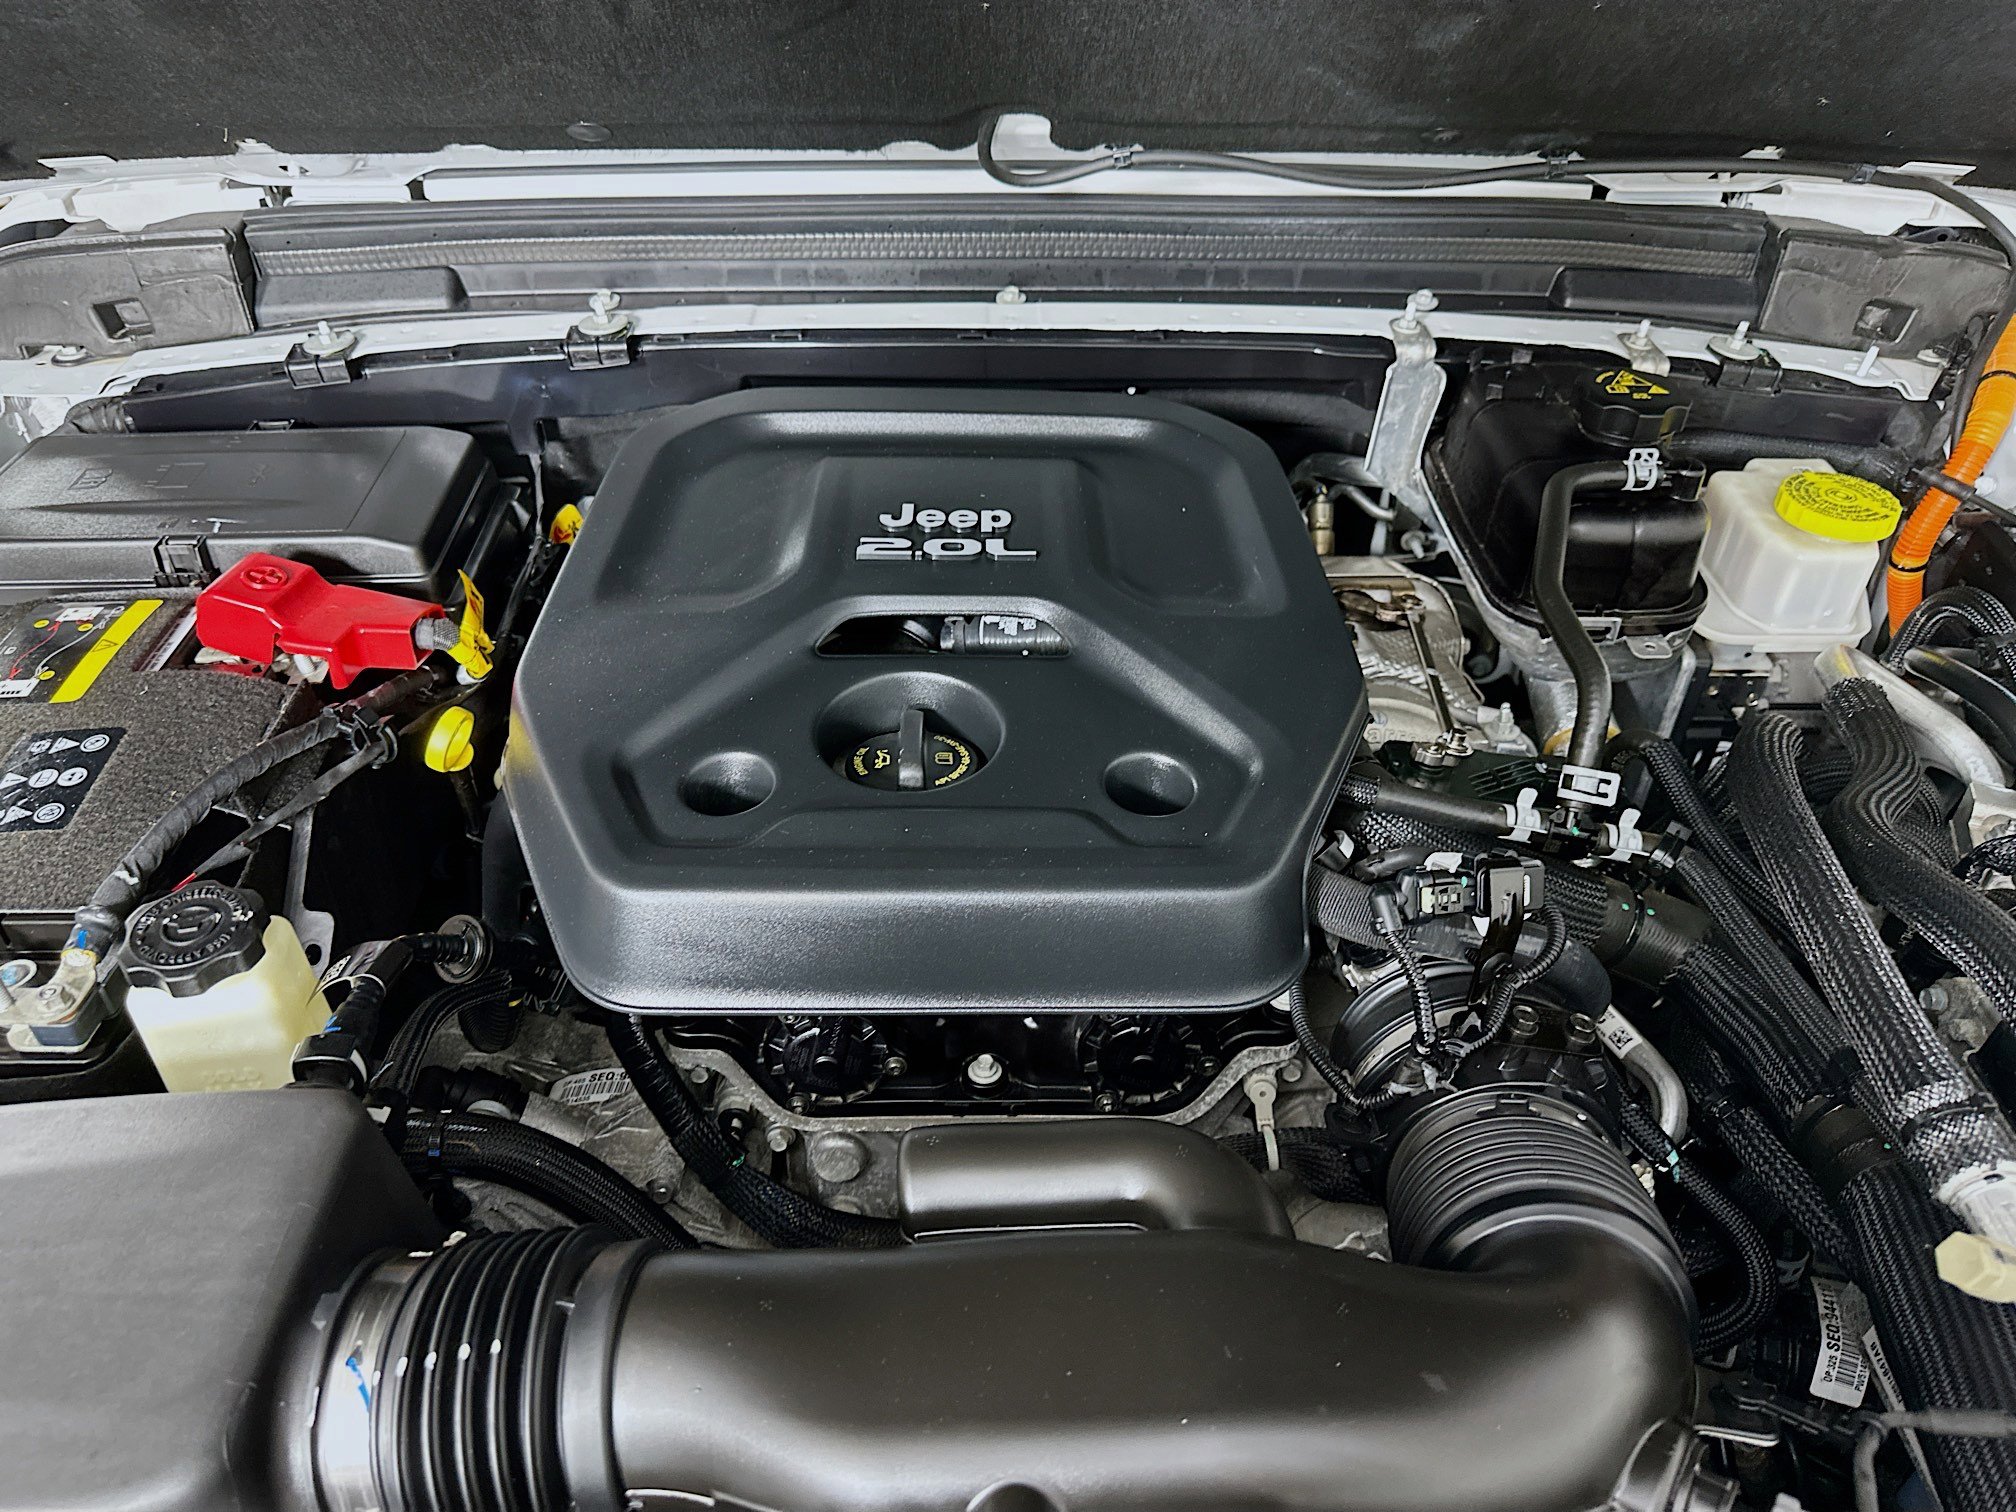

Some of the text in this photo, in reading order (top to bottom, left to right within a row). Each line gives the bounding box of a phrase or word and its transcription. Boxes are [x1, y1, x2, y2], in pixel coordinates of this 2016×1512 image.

[879, 503, 1012, 536] Jeep
[856, 537, 1037, 560] 2.0L
[853, 756, 869, 775] ENGINE
